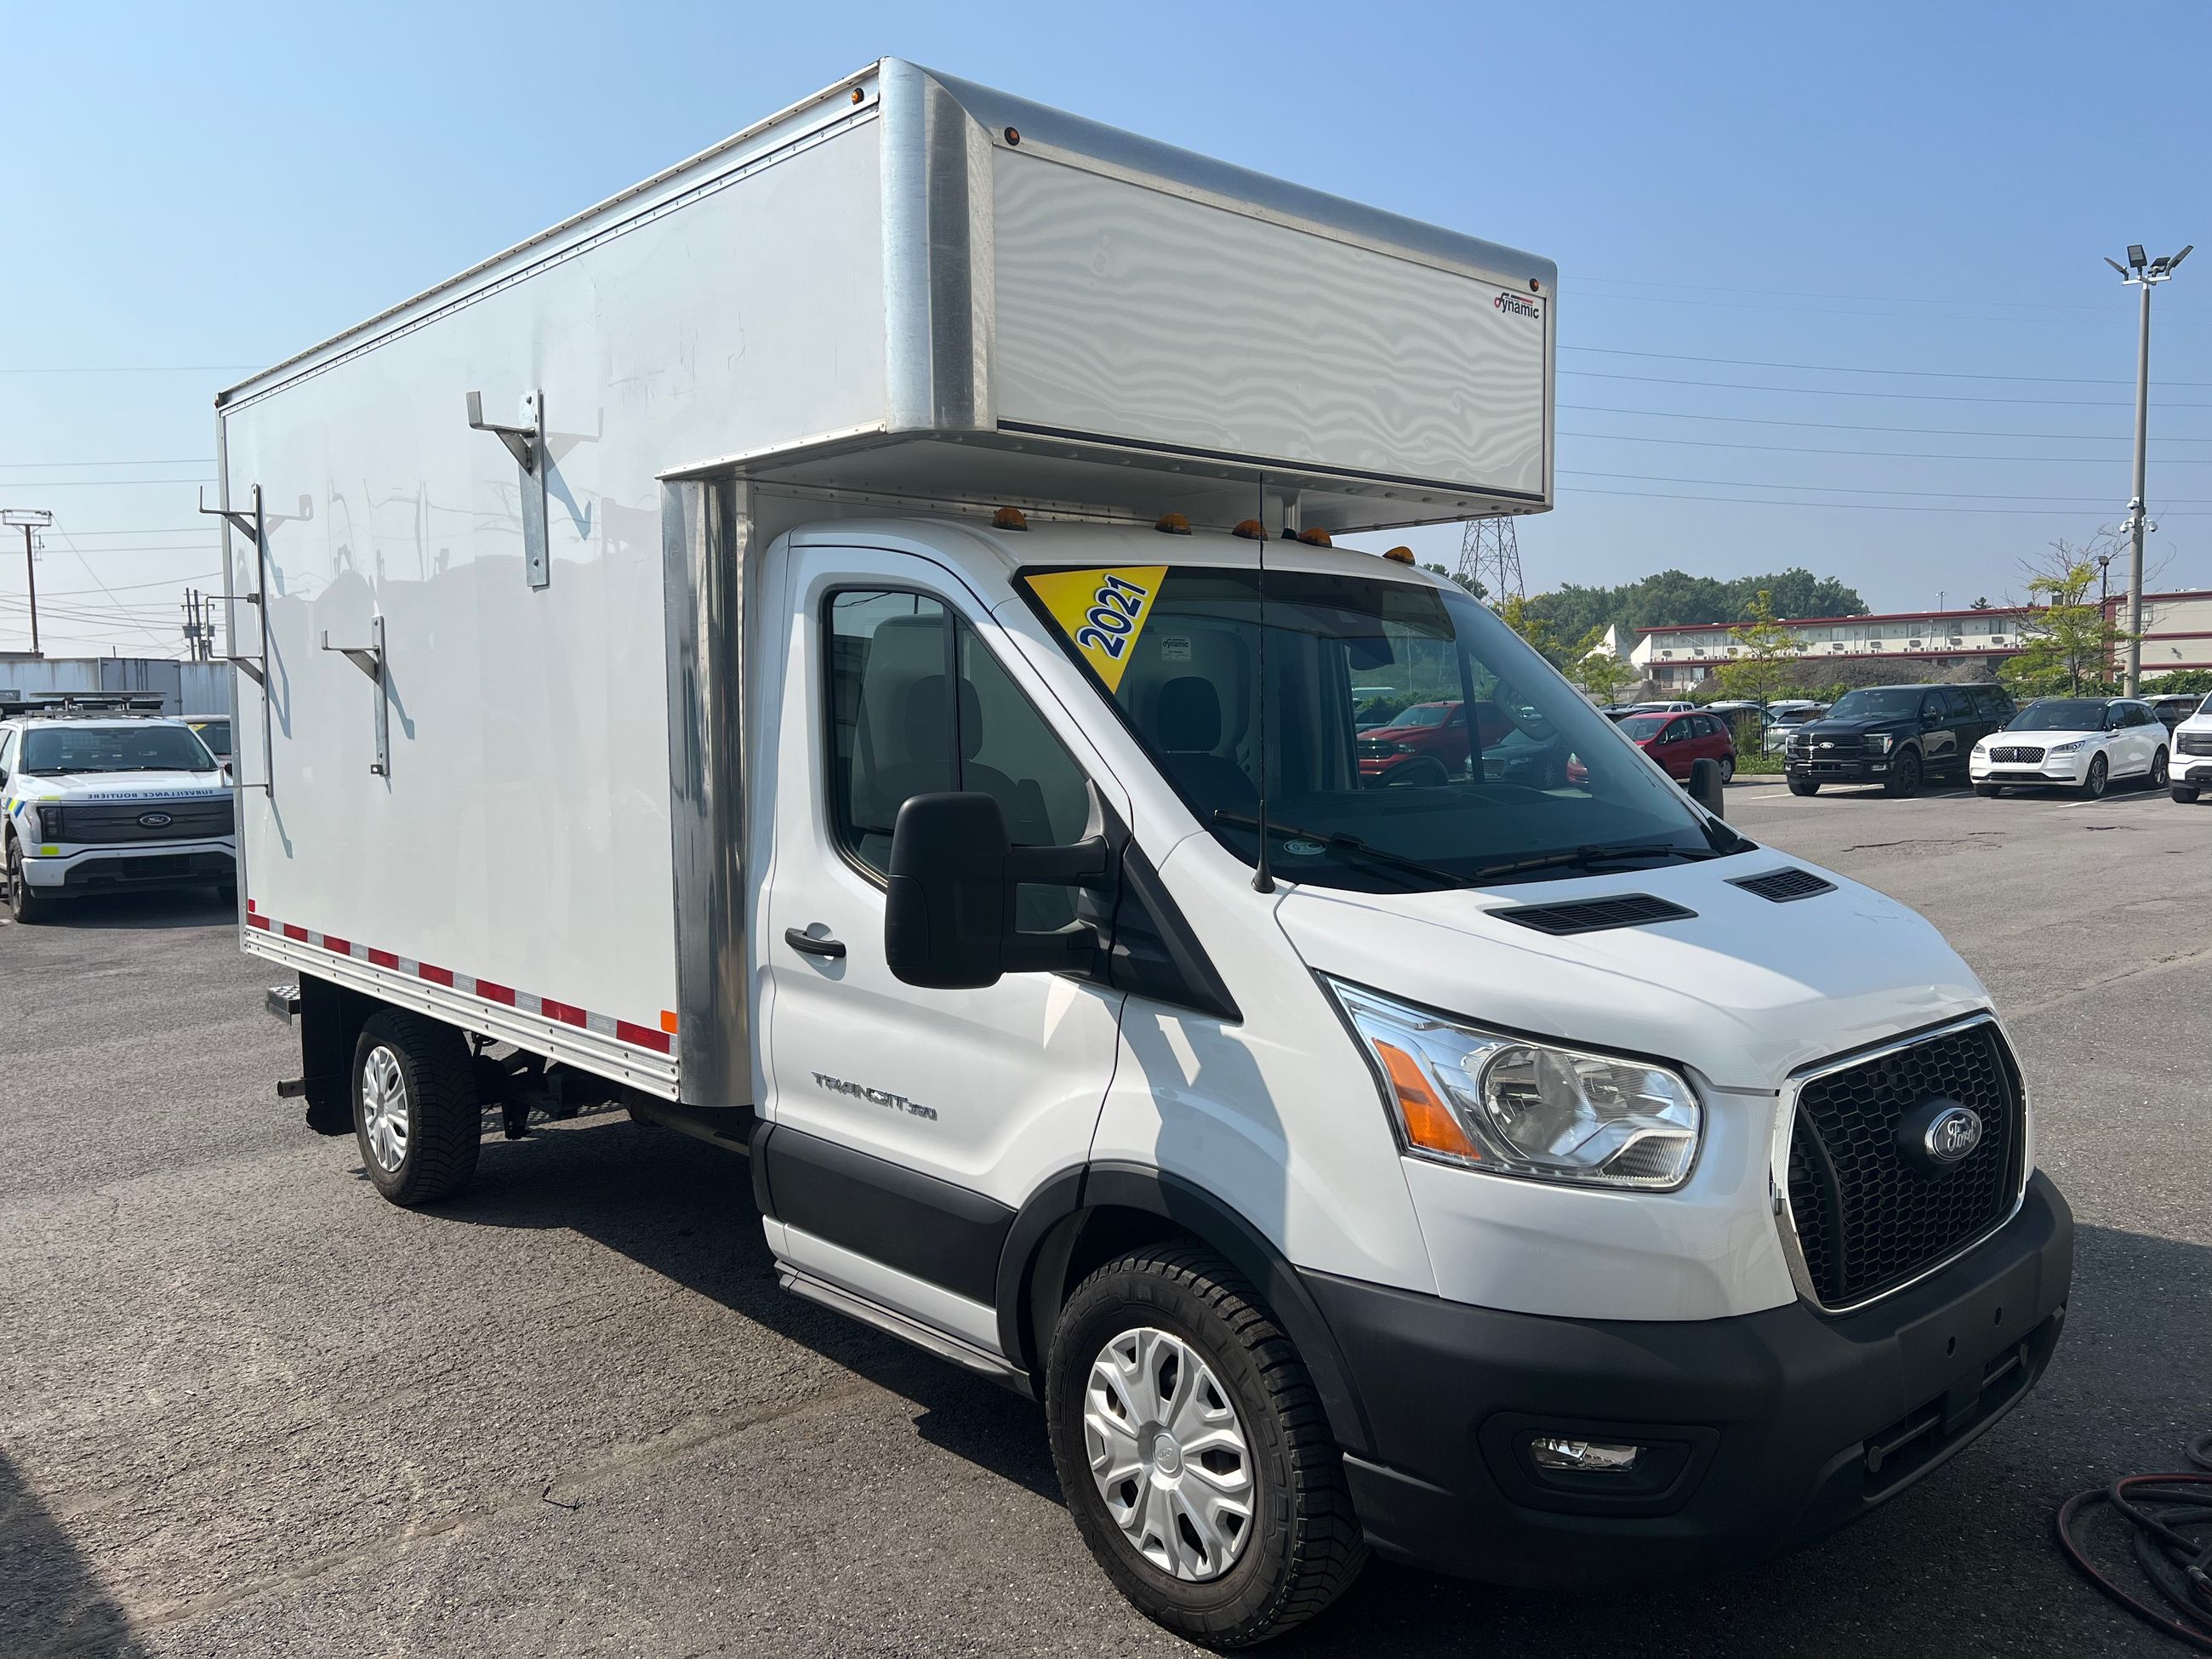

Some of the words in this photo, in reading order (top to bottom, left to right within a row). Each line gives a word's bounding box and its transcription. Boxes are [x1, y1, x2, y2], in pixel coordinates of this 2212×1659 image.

[1077, 573, 1149, 659] 2021
[811, 1071, 908, 1111] TRANSIT
[1947, 1118, 1975, 1152] Ford
